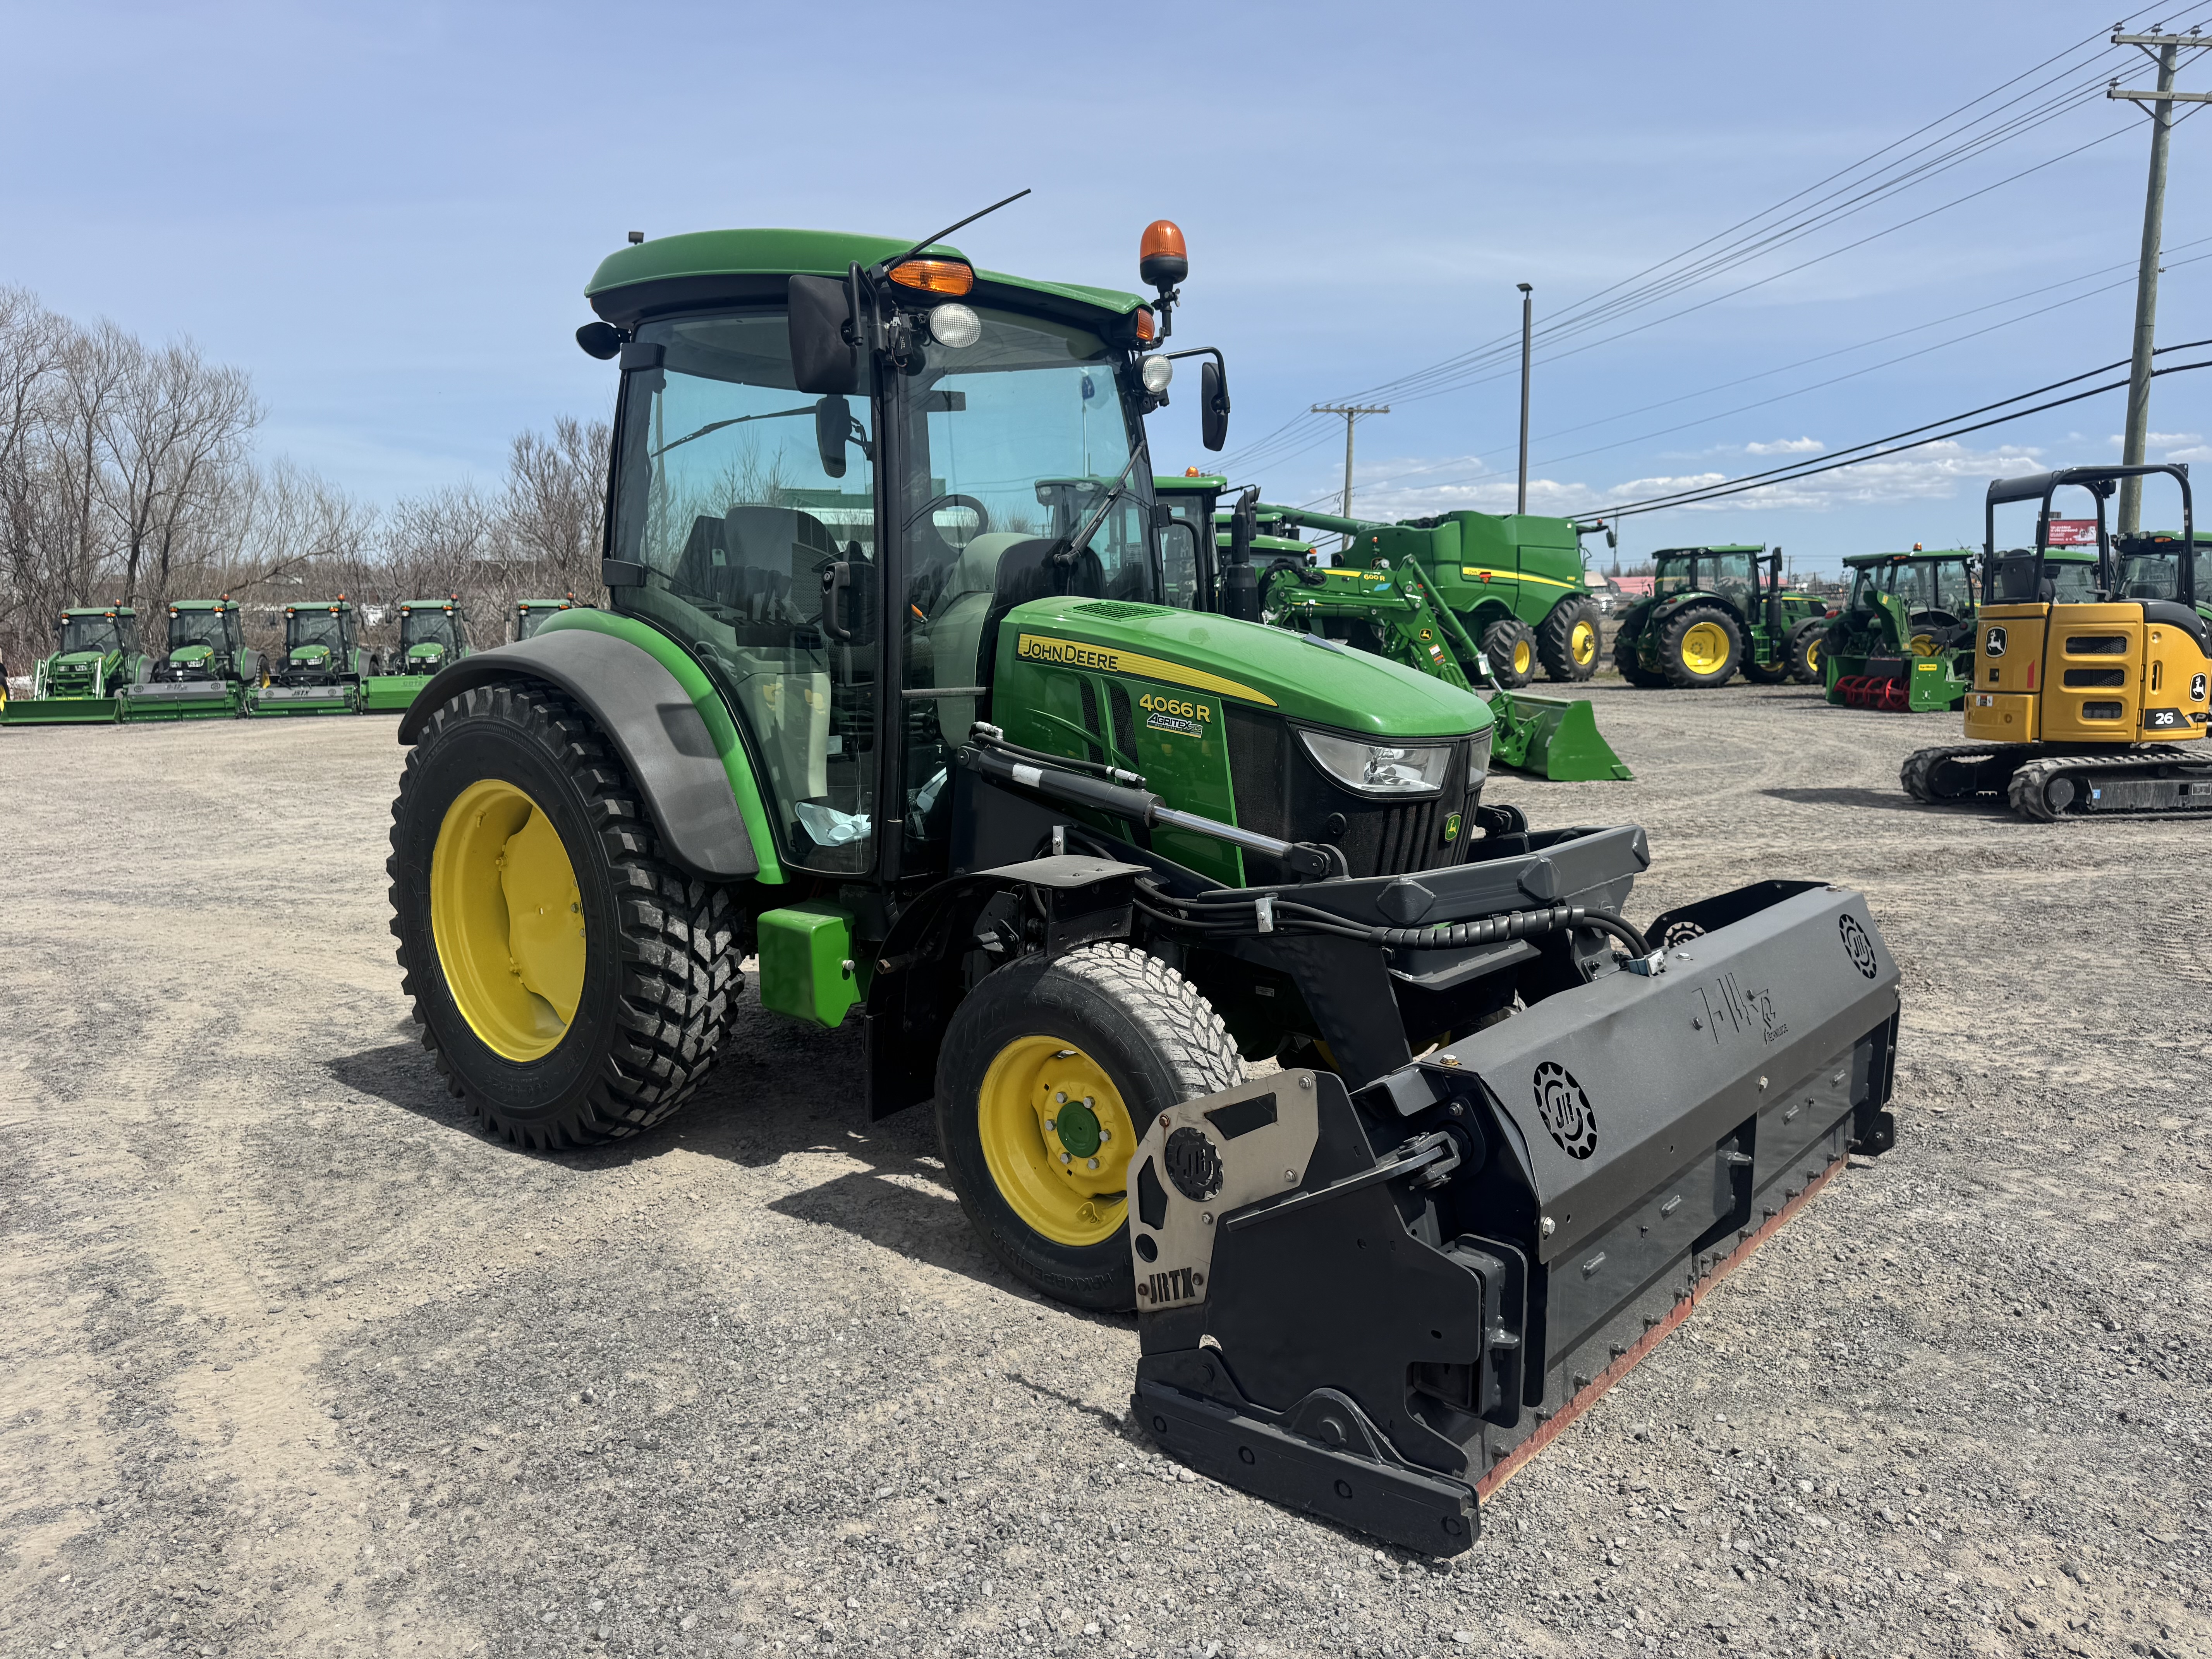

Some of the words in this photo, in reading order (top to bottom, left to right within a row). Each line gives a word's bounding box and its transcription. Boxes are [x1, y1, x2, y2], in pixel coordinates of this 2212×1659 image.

[1023, 639, 1062, 661] JOHN
[1066, 645, 1118, 670] DEERE
[1148, 714, 1192, 730] AGRITEX
[2155, 712, 2174, 725] 26
[1149, 1267, 1195, 1304] JRTX
